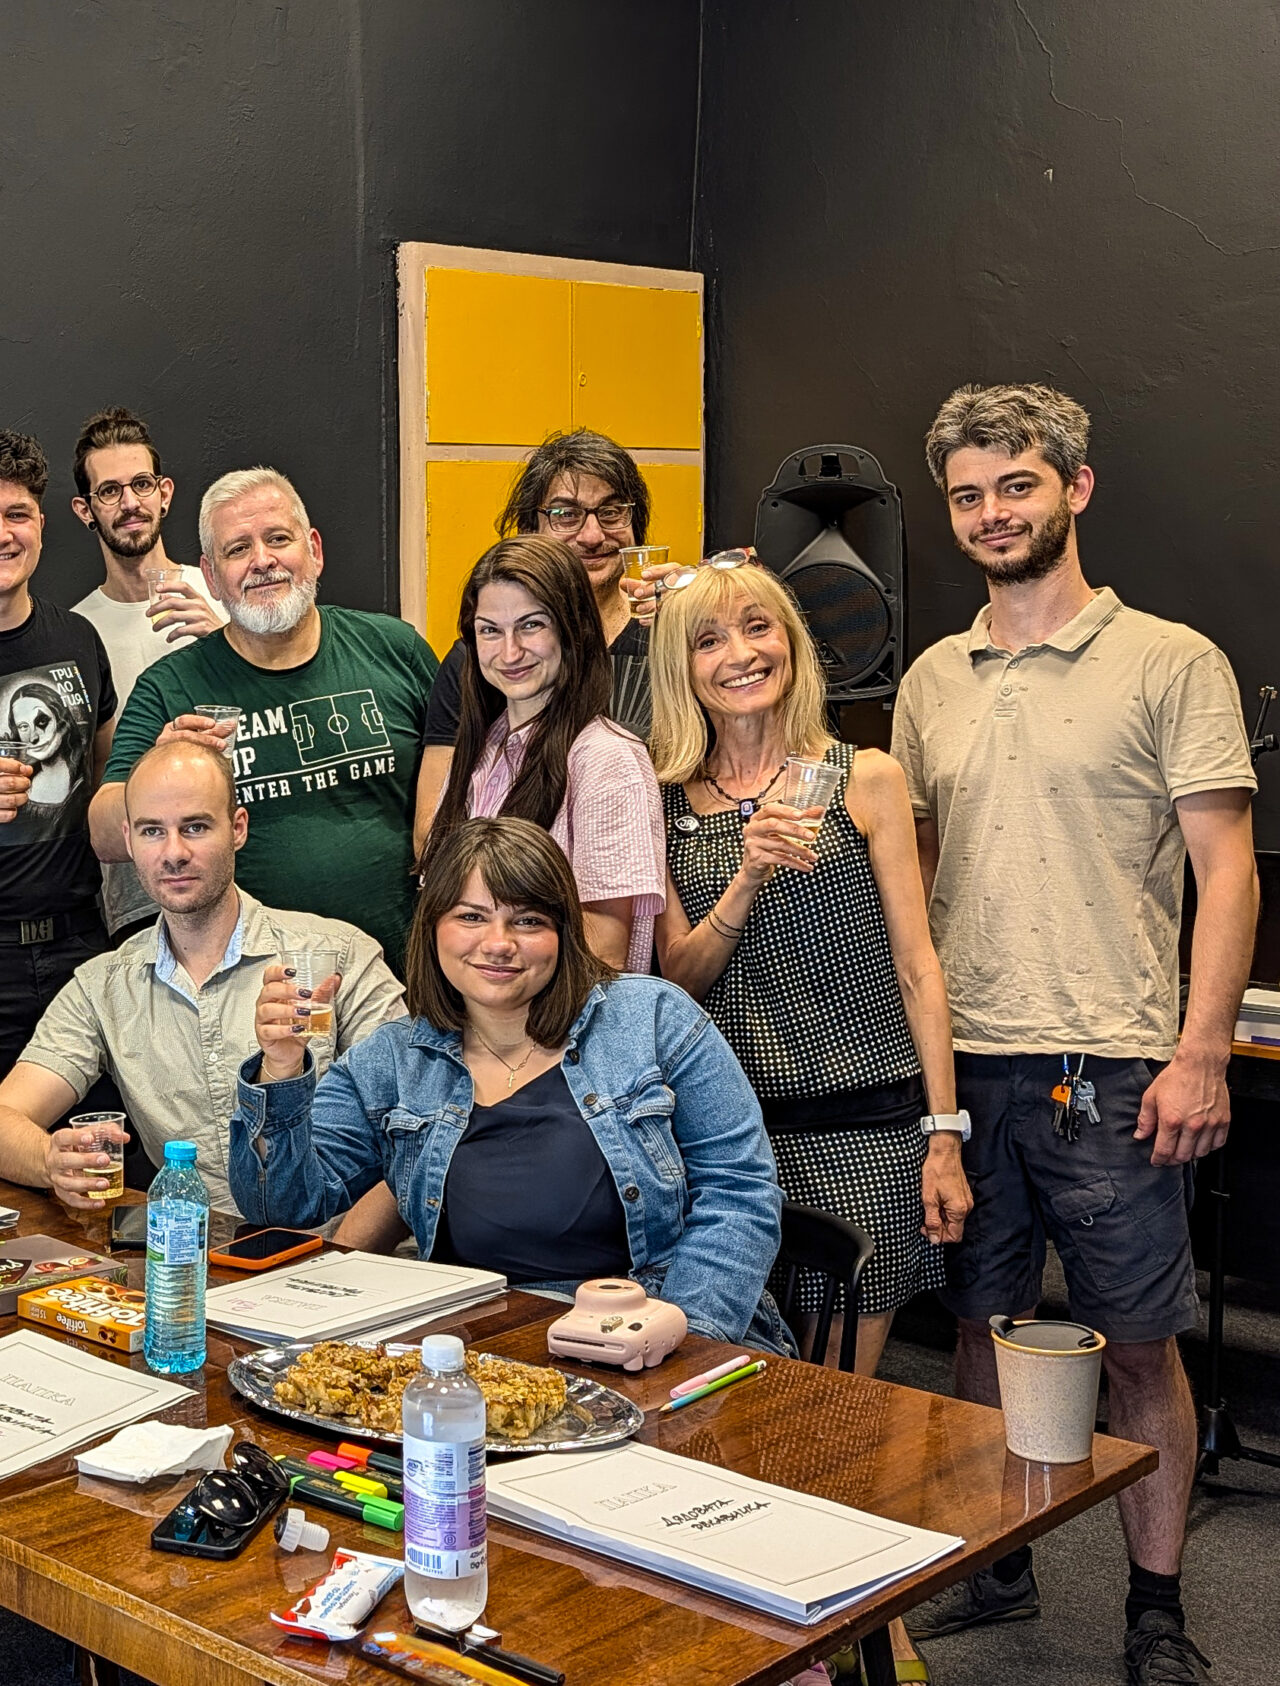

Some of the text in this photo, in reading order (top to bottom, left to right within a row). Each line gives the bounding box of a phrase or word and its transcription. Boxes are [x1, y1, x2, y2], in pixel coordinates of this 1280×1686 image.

[235, 706, 289, 742] EAM
[302, 769, 339, 792] THE
[350, 757, 395, 780] GAME
[47, 1288, 146, 1327] Toffifee
[56, 1312, 89, 1334] Toffifee
[594, 1482, 679, 1511] ПАПКА
[661, 1498, 735, 1527] ДЯДОВАТА
